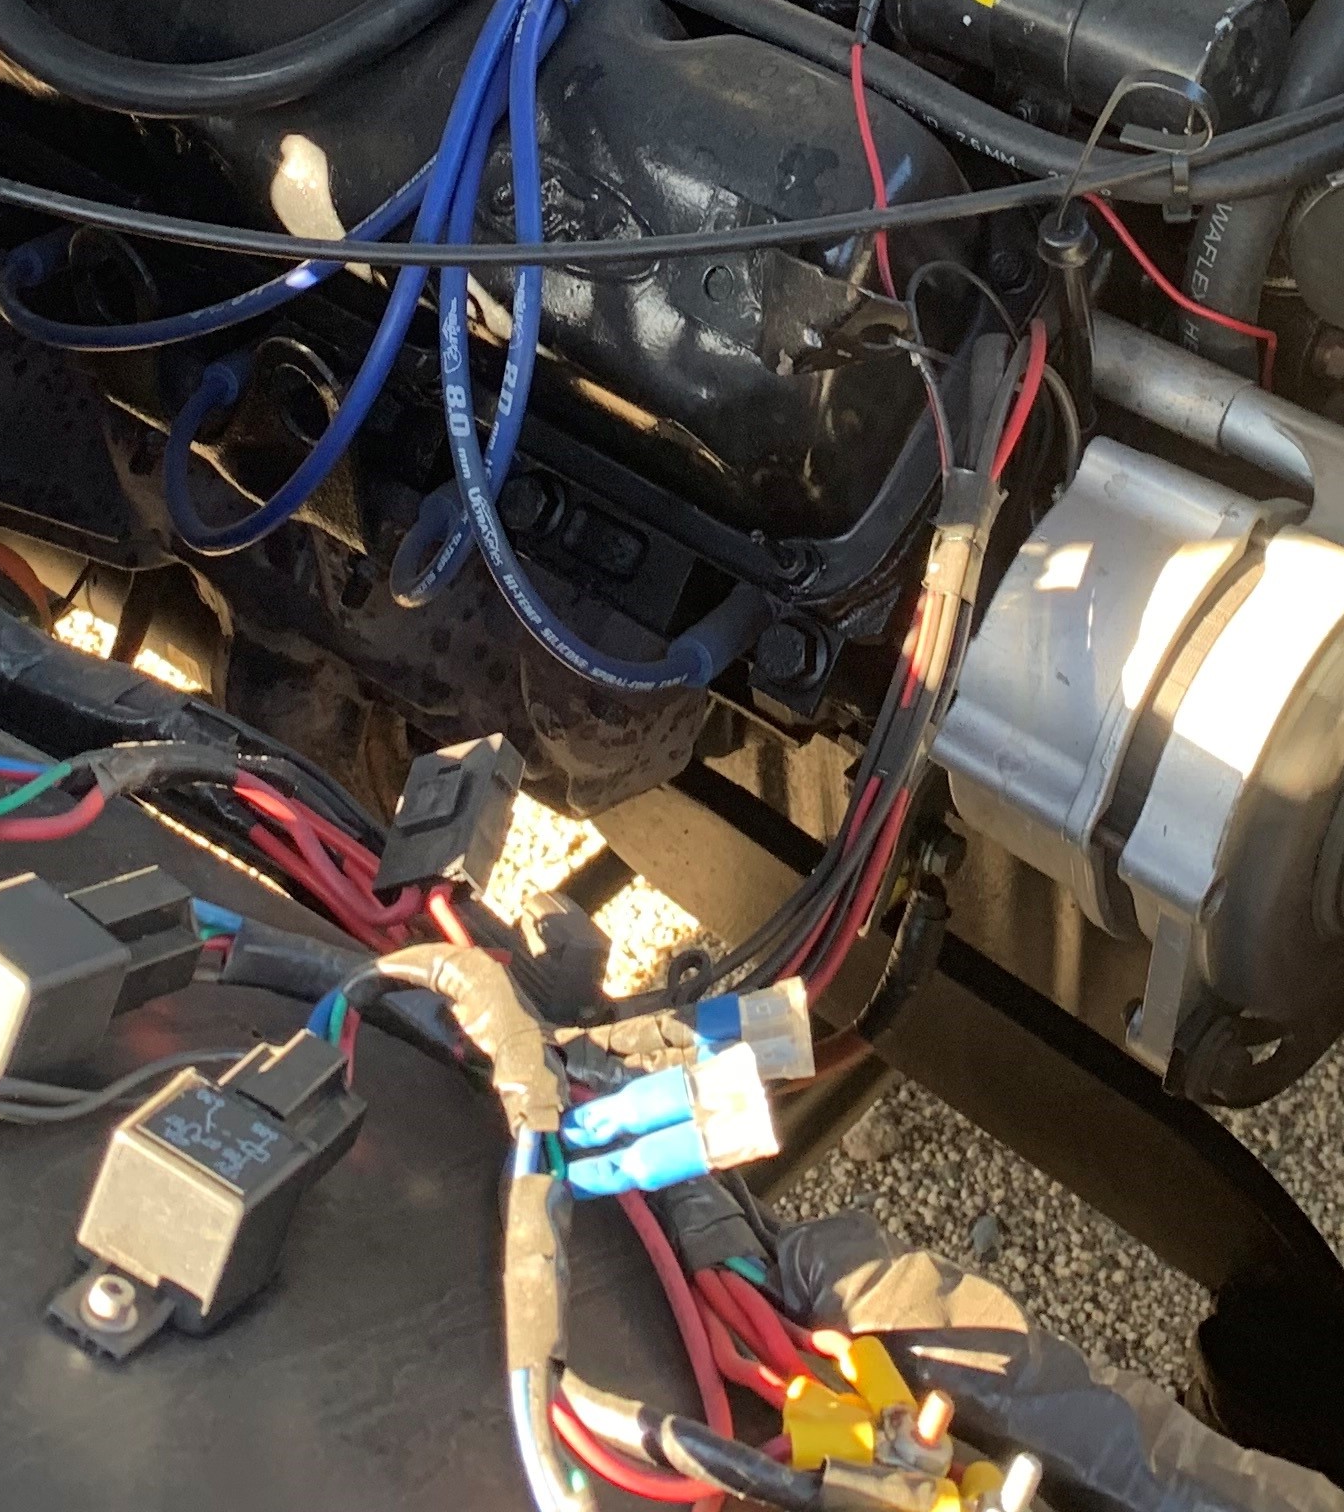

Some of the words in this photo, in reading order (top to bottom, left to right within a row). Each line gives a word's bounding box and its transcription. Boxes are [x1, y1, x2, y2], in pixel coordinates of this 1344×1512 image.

[444, 384, 471, 438] 8.0
[456, 446, 472, 480] mm
[502, 573, 543, 626] HI-TEMP
[540, 627, 590, 671] SILICONE
